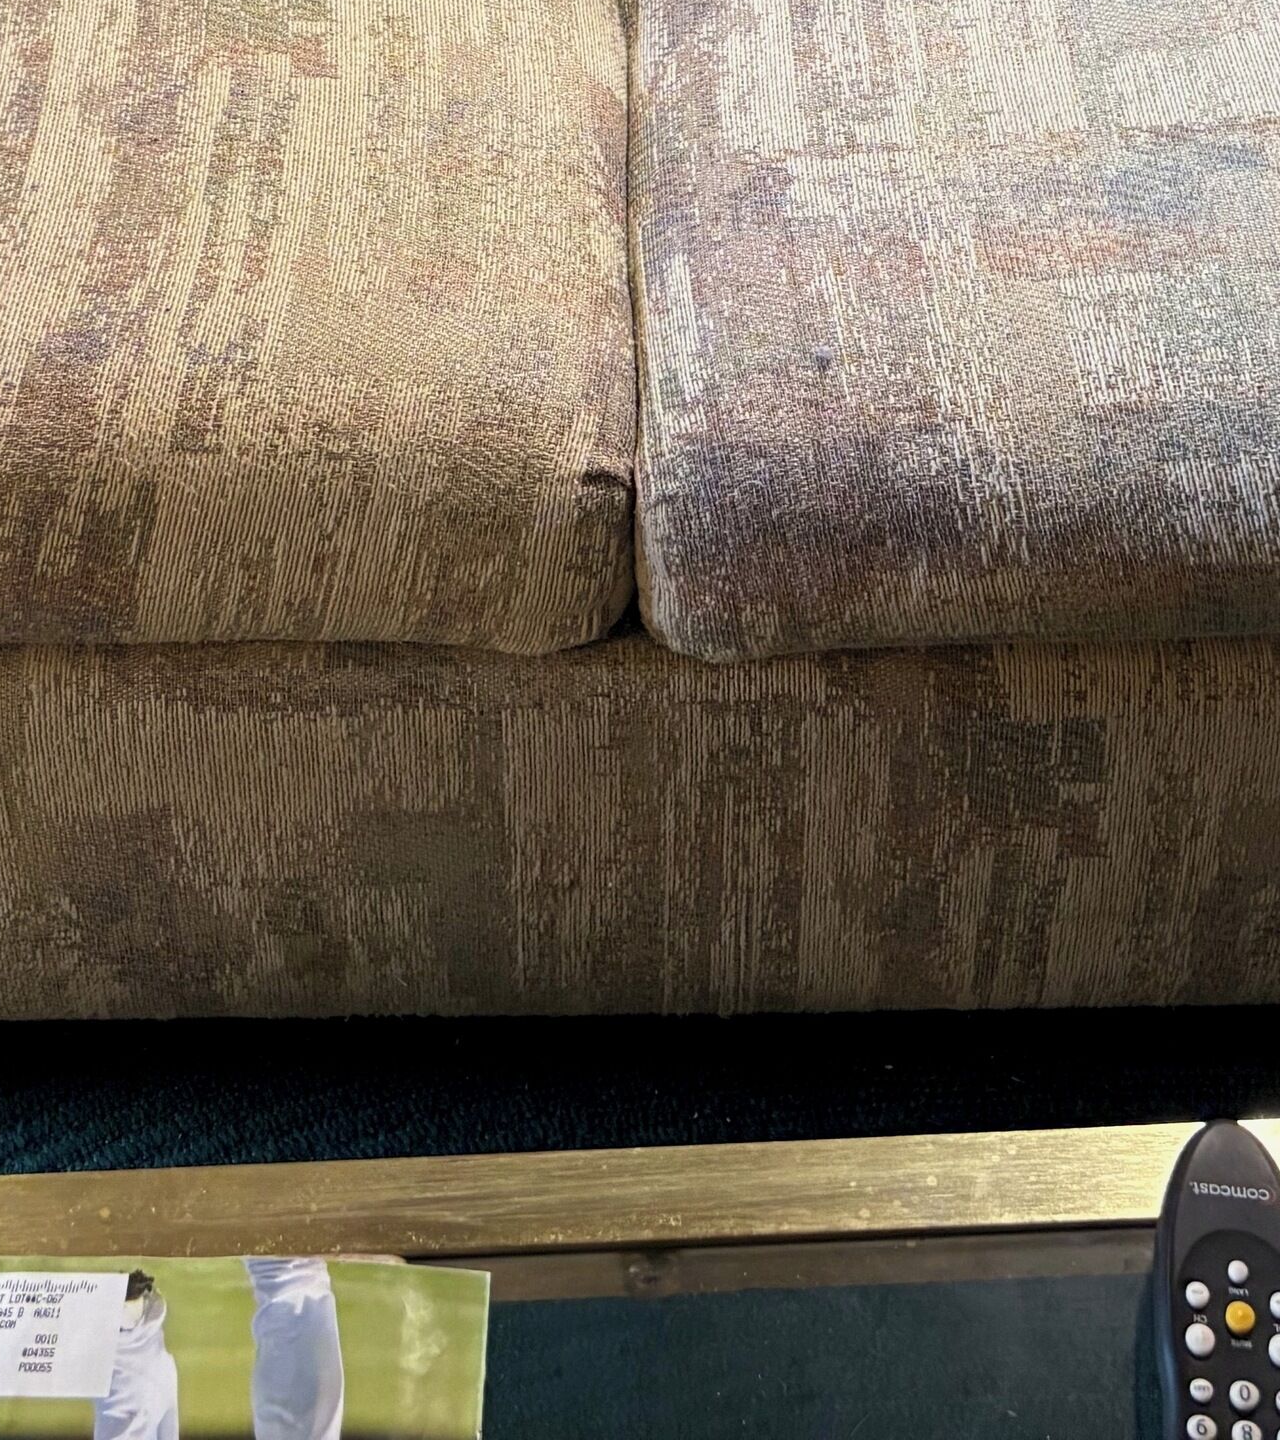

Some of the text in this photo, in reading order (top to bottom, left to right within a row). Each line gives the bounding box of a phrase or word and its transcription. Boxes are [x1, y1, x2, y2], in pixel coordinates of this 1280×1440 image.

[1193, 1181, 1270, 1201] comcast
[0, 1318, 17, 1329] COM
[1193, 1314, 1208, 1323] CH
[1238, 1384, 1251, 1401] 0
[1195, 1418, 1207, 1434] 9
